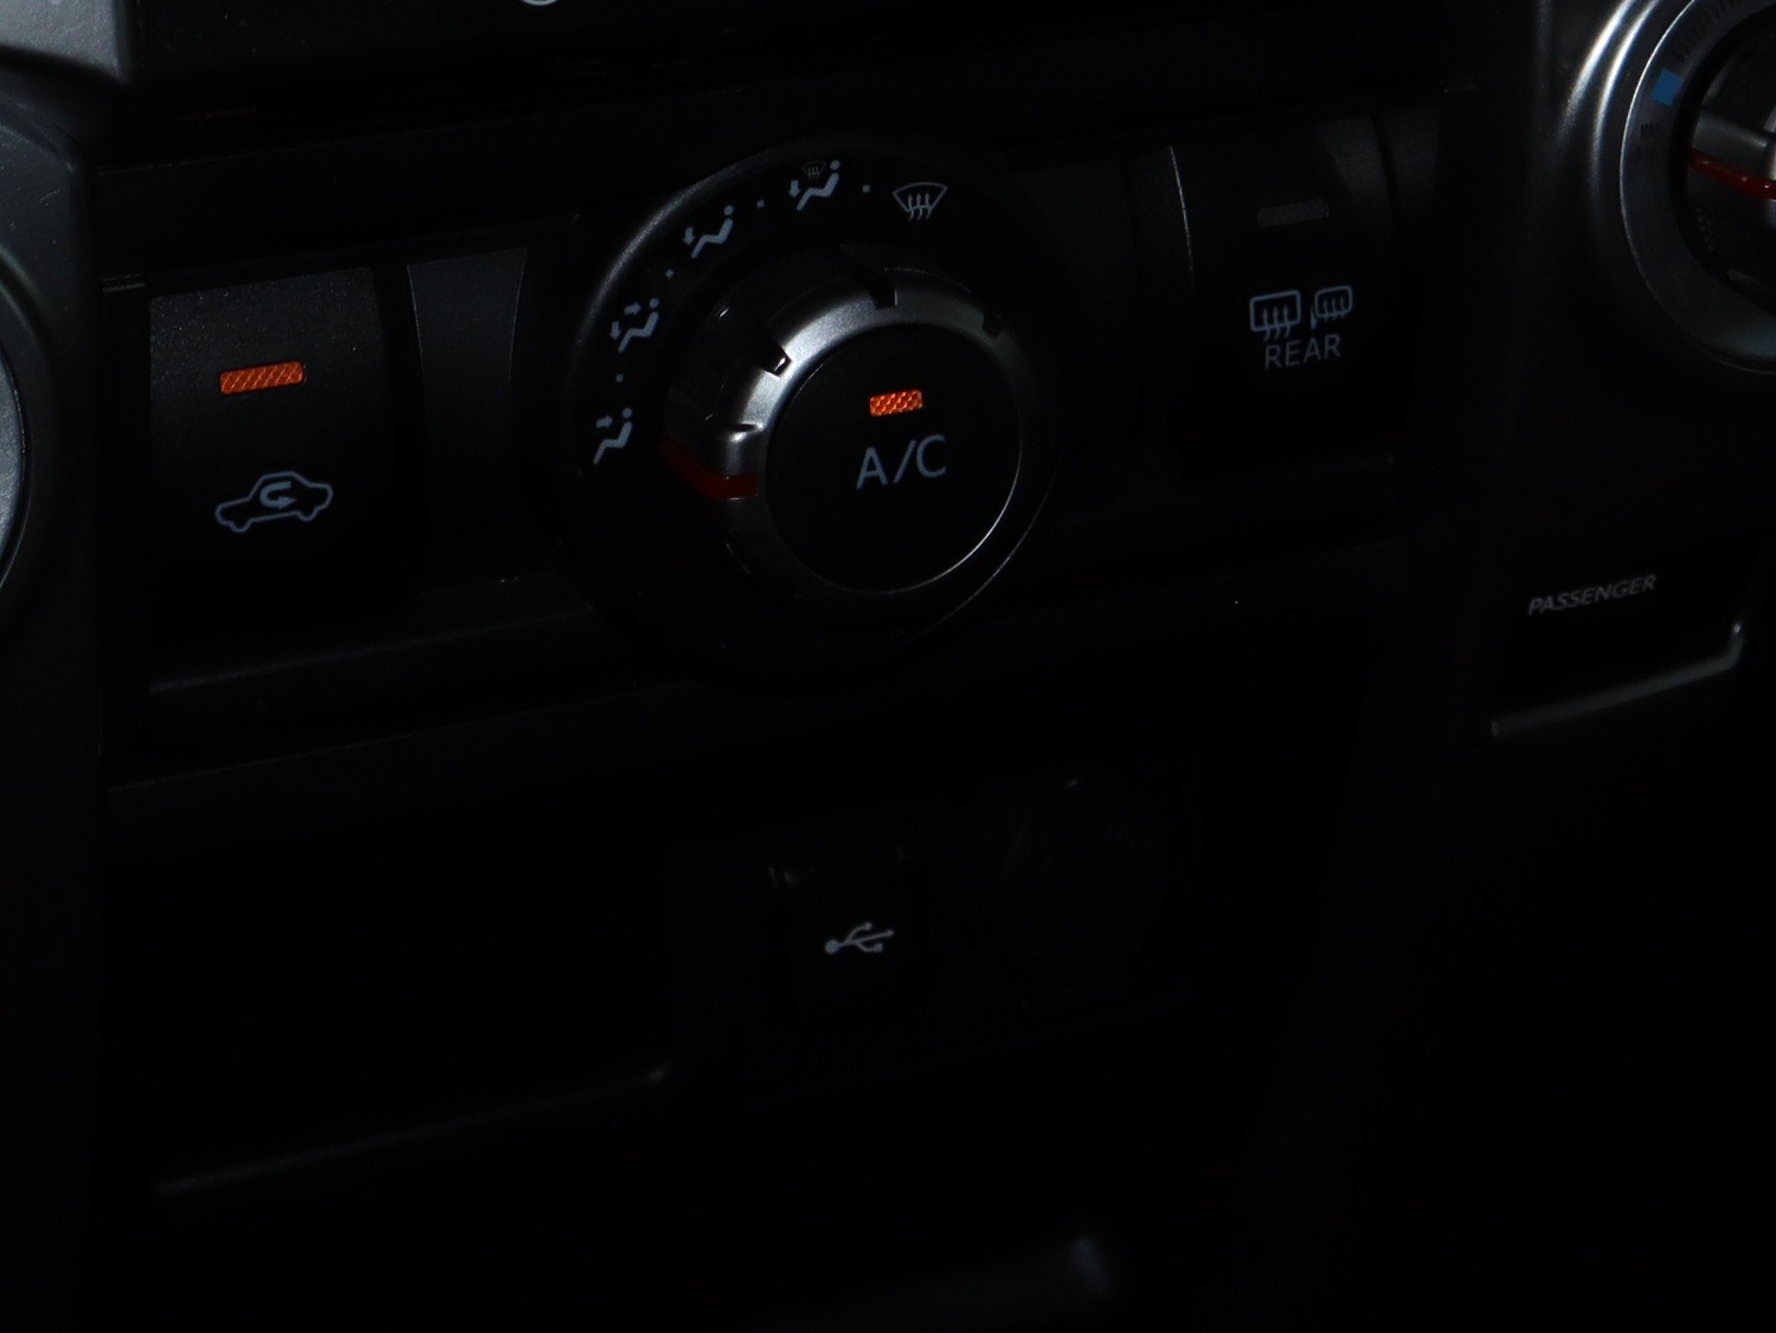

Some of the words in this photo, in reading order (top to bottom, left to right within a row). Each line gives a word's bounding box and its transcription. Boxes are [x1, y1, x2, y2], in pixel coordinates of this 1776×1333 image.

[1263, 333, 1343, 371] REAR
[855, 433, 948, 491] A/C
[1527, 573, 1659, 616] PASSENGER
